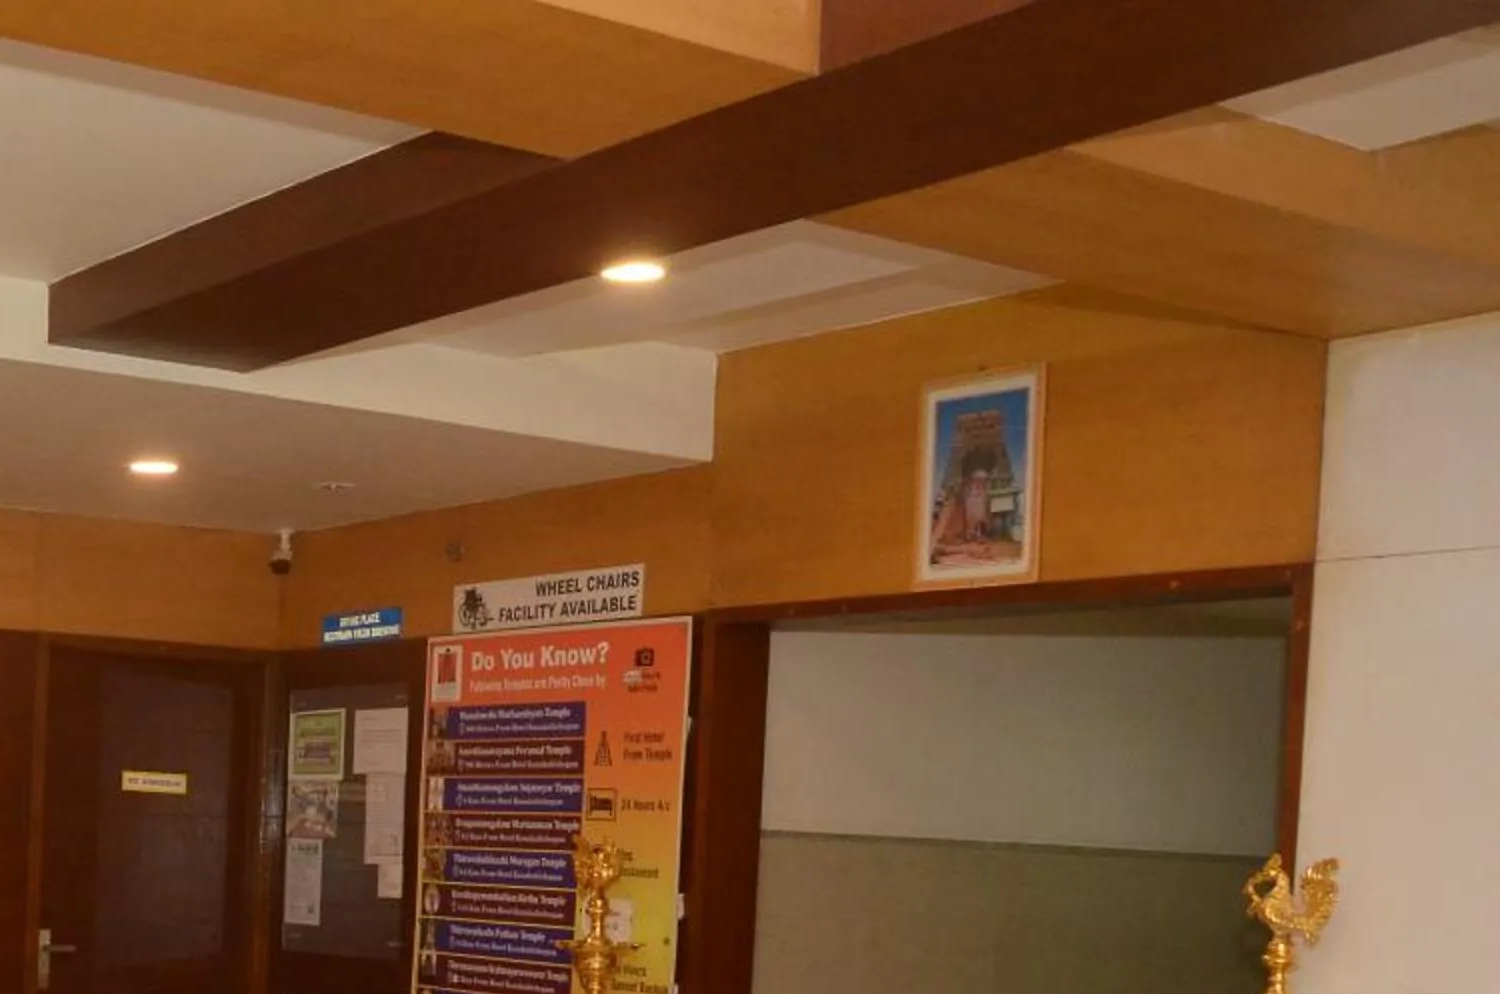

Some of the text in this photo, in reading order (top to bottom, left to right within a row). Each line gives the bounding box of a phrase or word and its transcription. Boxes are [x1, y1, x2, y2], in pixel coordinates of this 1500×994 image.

[535, 571, 640, 597] WHEEL CHAIRS
[500, 595, 637, 623] FACILITY AVAILABLE
[472, 641, 610, 671] Do You Know?
